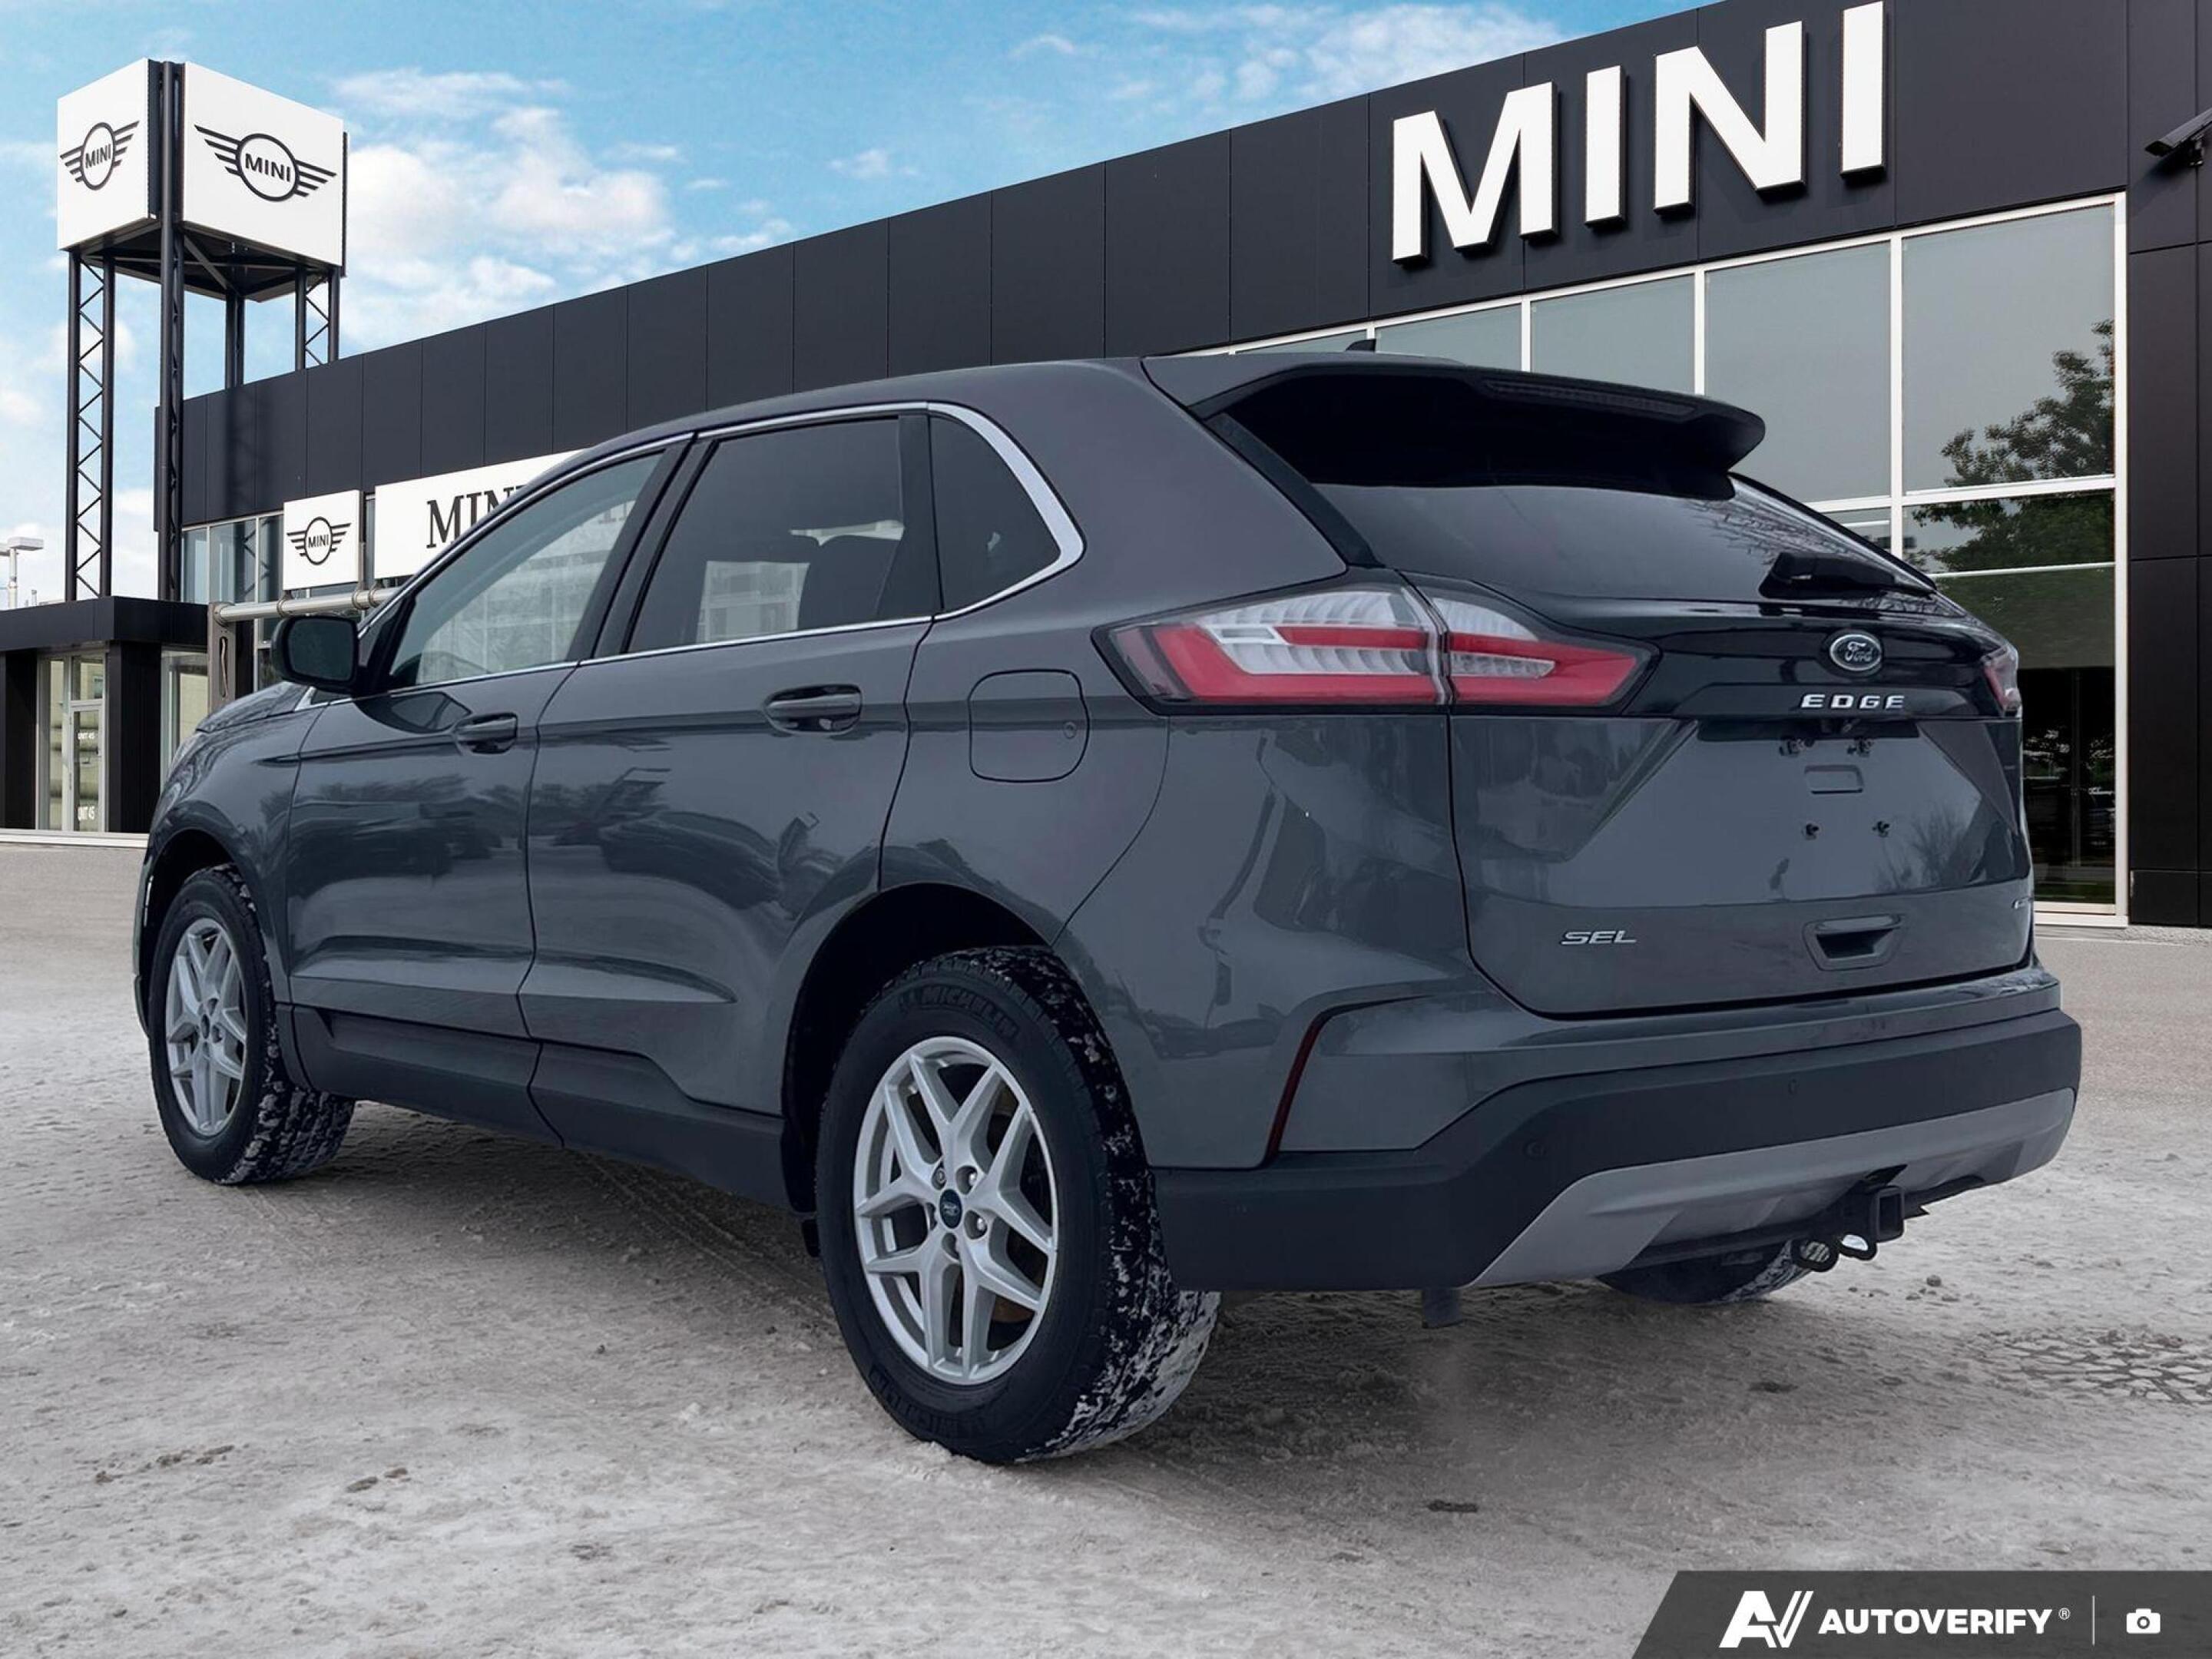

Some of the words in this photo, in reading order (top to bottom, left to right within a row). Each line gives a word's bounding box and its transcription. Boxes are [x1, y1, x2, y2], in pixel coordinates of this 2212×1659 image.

[1392, 1, 1886, 264] MINI
[85, 143, 111, 169] MINI
[245, 153, 291, 182] MINI
[308, 534, 329, 548] MINI
[1845, 641, 1873, 662] Ford
[1801, 694, 1905, 709] EDGE
[1561, 930, 1637, 945] SEL
